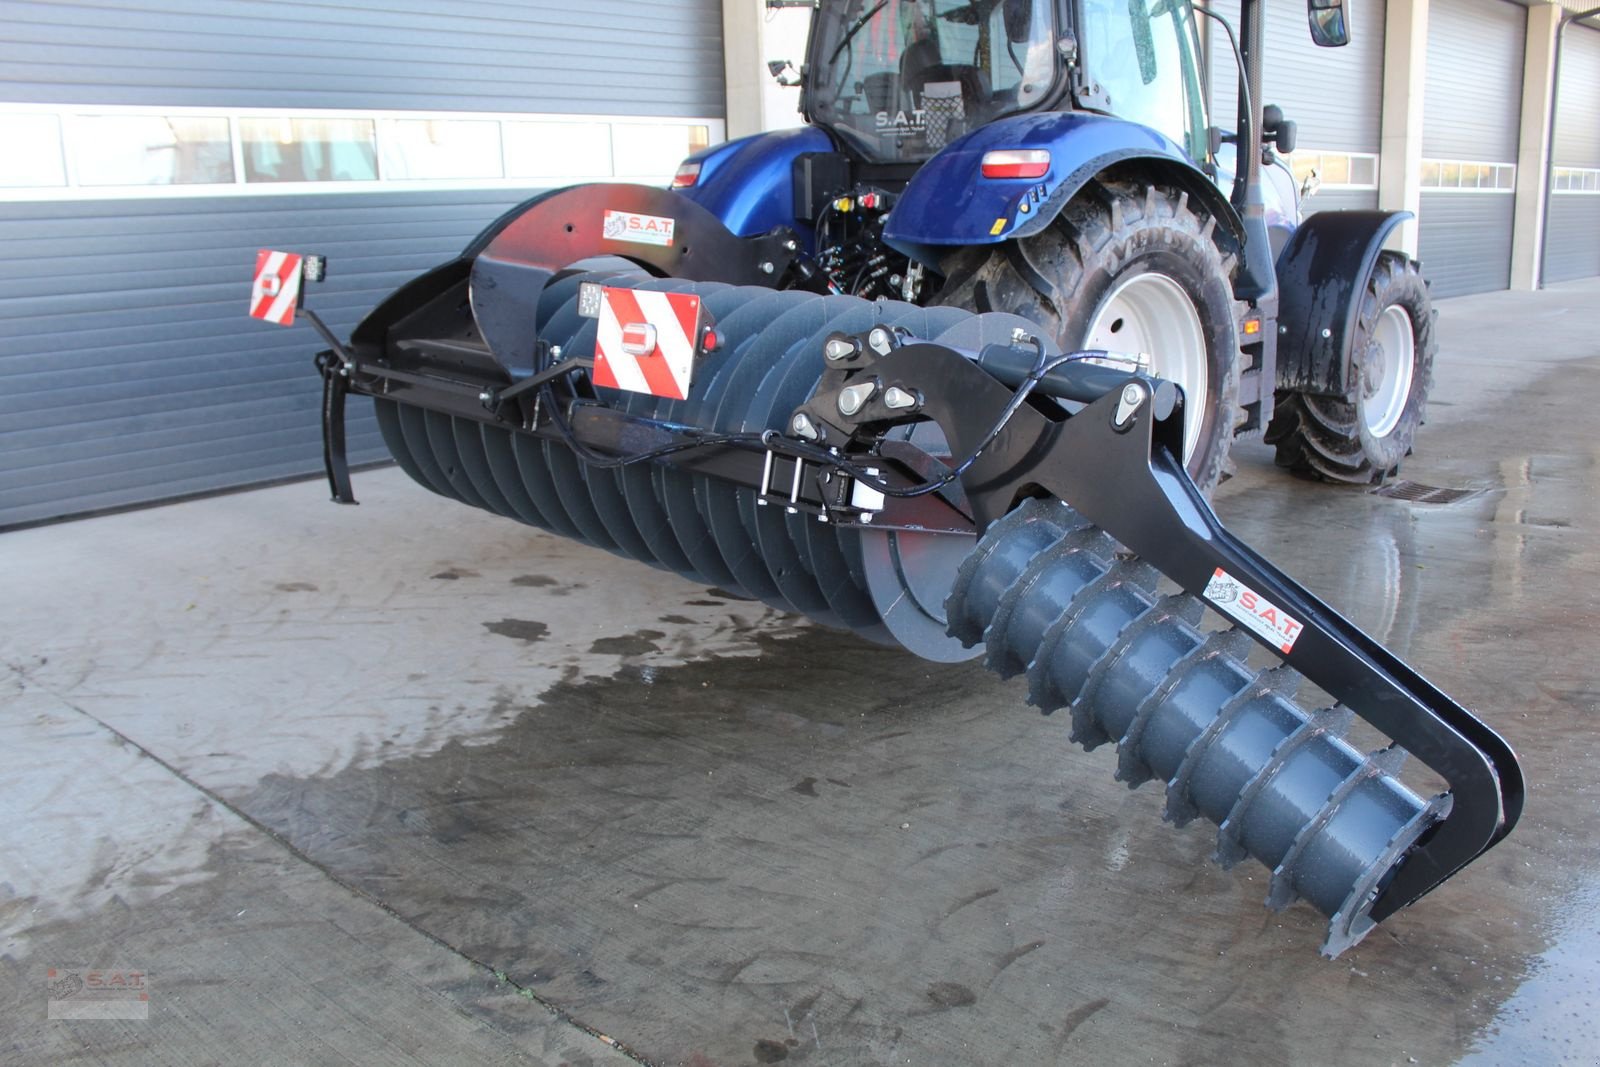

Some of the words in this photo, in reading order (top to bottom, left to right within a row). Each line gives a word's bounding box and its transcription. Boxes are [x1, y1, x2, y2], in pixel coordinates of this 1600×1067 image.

[875, 110, 926, 126] S.A.T.
[629, 217, 672, 233] S.A.T.
[1239, 591, 1299, 638] S.A.T.
